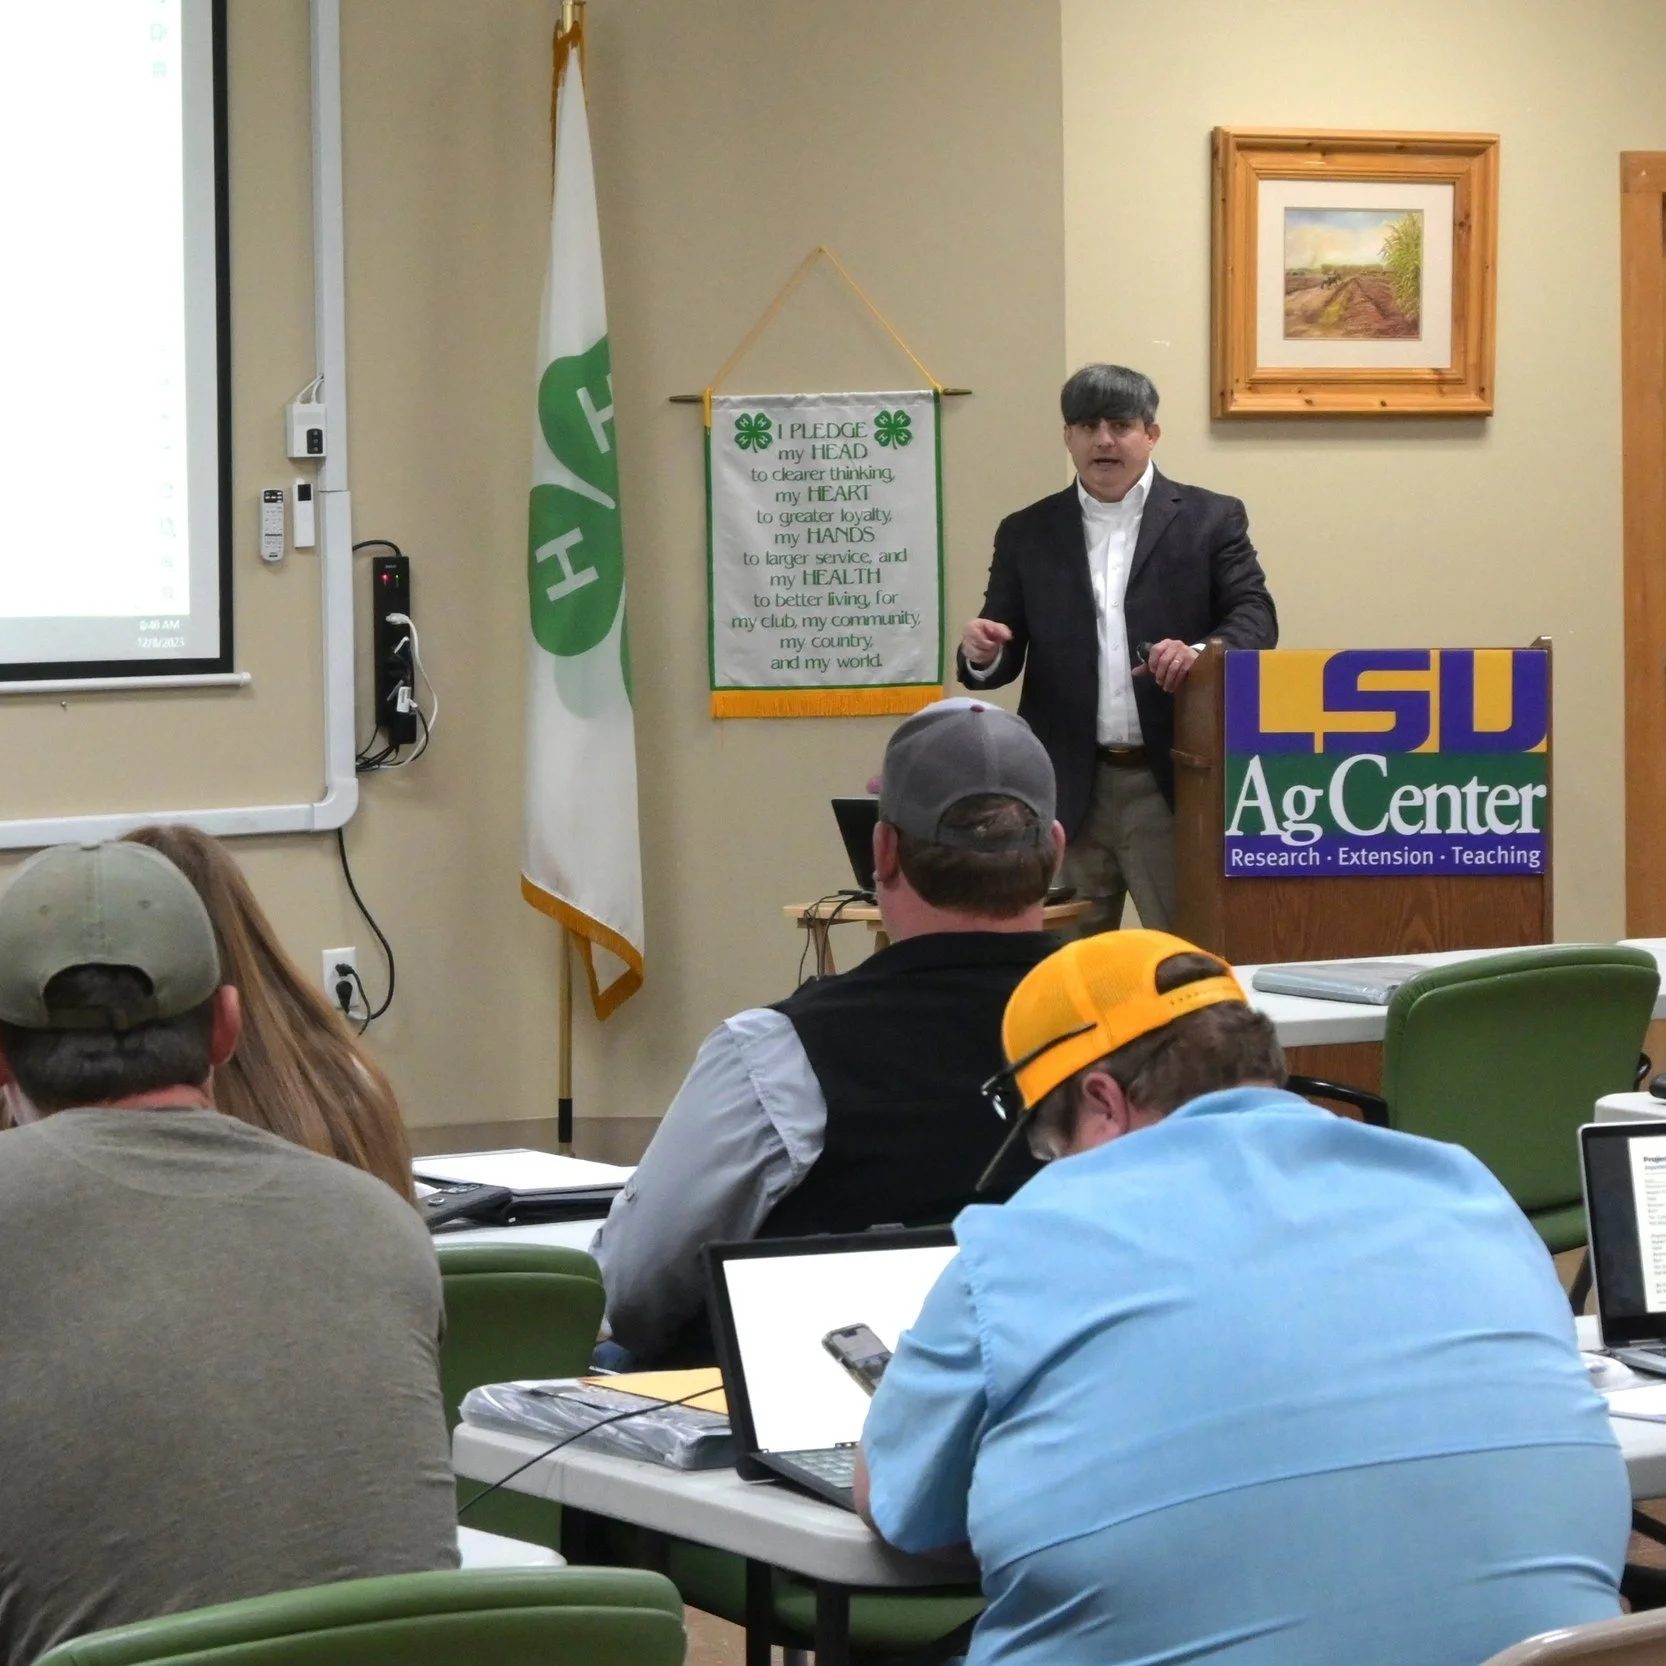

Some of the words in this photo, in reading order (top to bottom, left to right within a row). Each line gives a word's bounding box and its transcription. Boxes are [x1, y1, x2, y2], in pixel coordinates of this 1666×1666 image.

[777, 423, 783, 440] I
[790, 421, 868, 439] PLEDGE
[778, 449, 804, 465] my
[811, 443, 869, 460] HEAD
[751, 467, 768, 482] to
[772, 466, 826, 482] clearer
[830, 465, 896, 484] thinking,
[775, 490, 801, 506] my
[807, 484, 872, 502] HEART
[756, 509, 774, 524] to
[779, 508, 834, 527] greater
[840, 507, 892, 526] loyalty,
[774, 532, 800, 548] my
[807, 526, 876, 544] HANDS
[535, 527, 600, 602] H
[743, 551, 760, 566] to
[766, 550, 810, 569] larger
[815, 549, 873, 565] service,
[878, 548, 908, 563] and
[769, 575, 796, 591] my
[802, 568, 881, 586] HEALTH
[754, 593, 771, 608] to
[775, 592, 823, 607] better
[827, 591, 871, 609] living,
[875, 589, 900, 605] for
[731, 616, 757, 632] my
[760, 613, 798, 629] club,
[802, 615, 828, 632] my
[831, 610, 921, 629] community,
[780, 636, 806, 653] my
[811, 633, 873, 651] country,
[770, 655, 799, 670] and
[805, 657, 830, 673] my
[837, 653, 883, 669] world.
[1225, 650, 1548, 753] LSU
[1225, 754, 1547, 846] AgCenter
[1231, 847, 1320, 867] Research
[1338, 846, 1434, 866] Extension
[1451, 845, 1541, 868] Teaching
